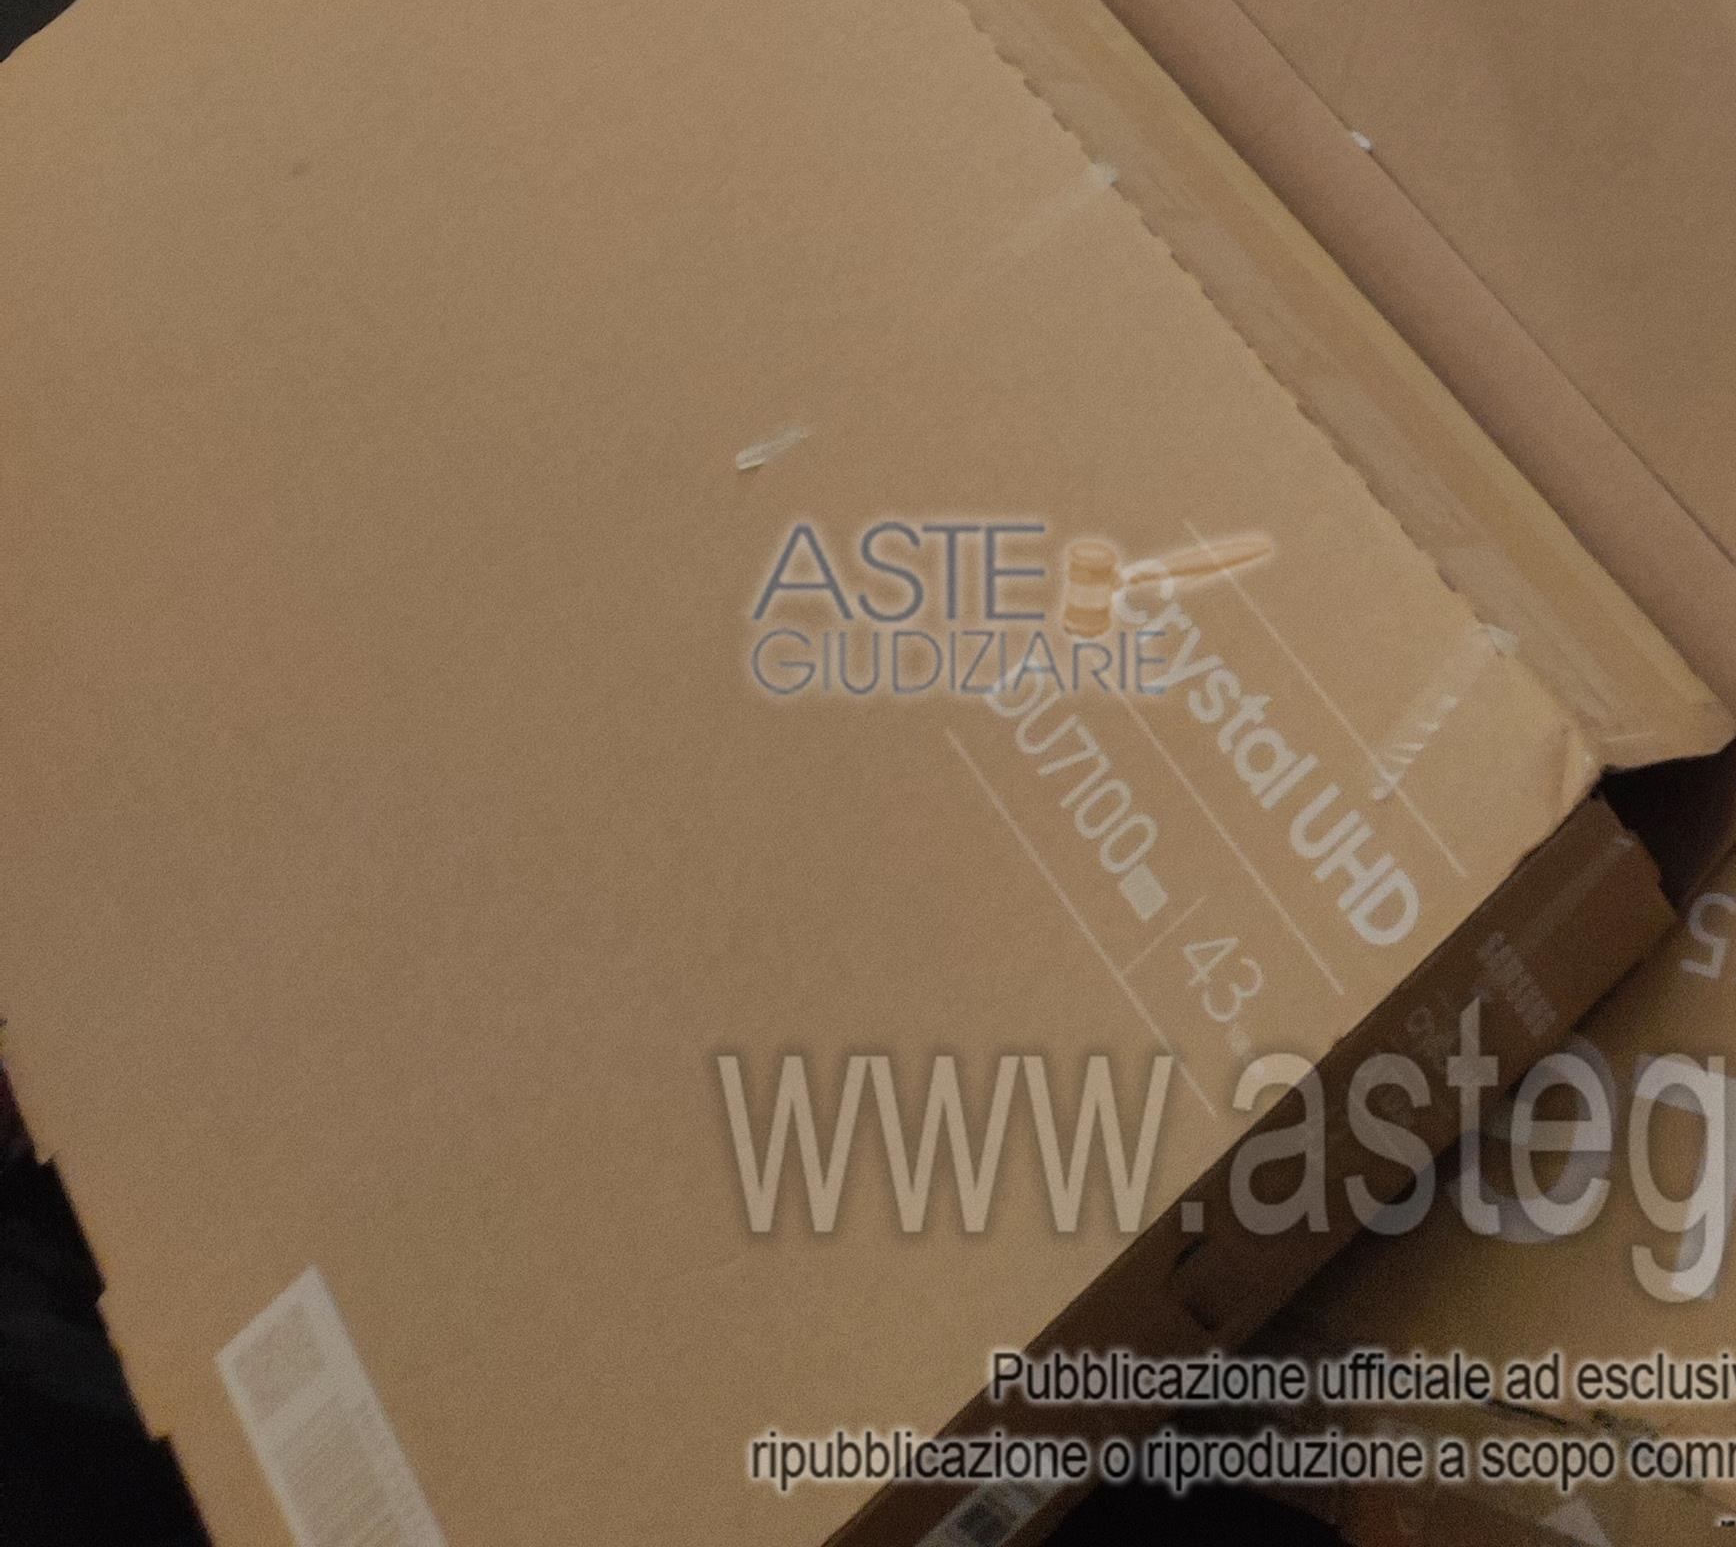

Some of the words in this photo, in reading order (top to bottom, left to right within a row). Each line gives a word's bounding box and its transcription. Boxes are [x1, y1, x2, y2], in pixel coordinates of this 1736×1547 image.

[1113, 559, 1316, 809] Crystal
[1288, 782, 1419, 947] UHD
[1183, 935, 1265, 1023] 43
